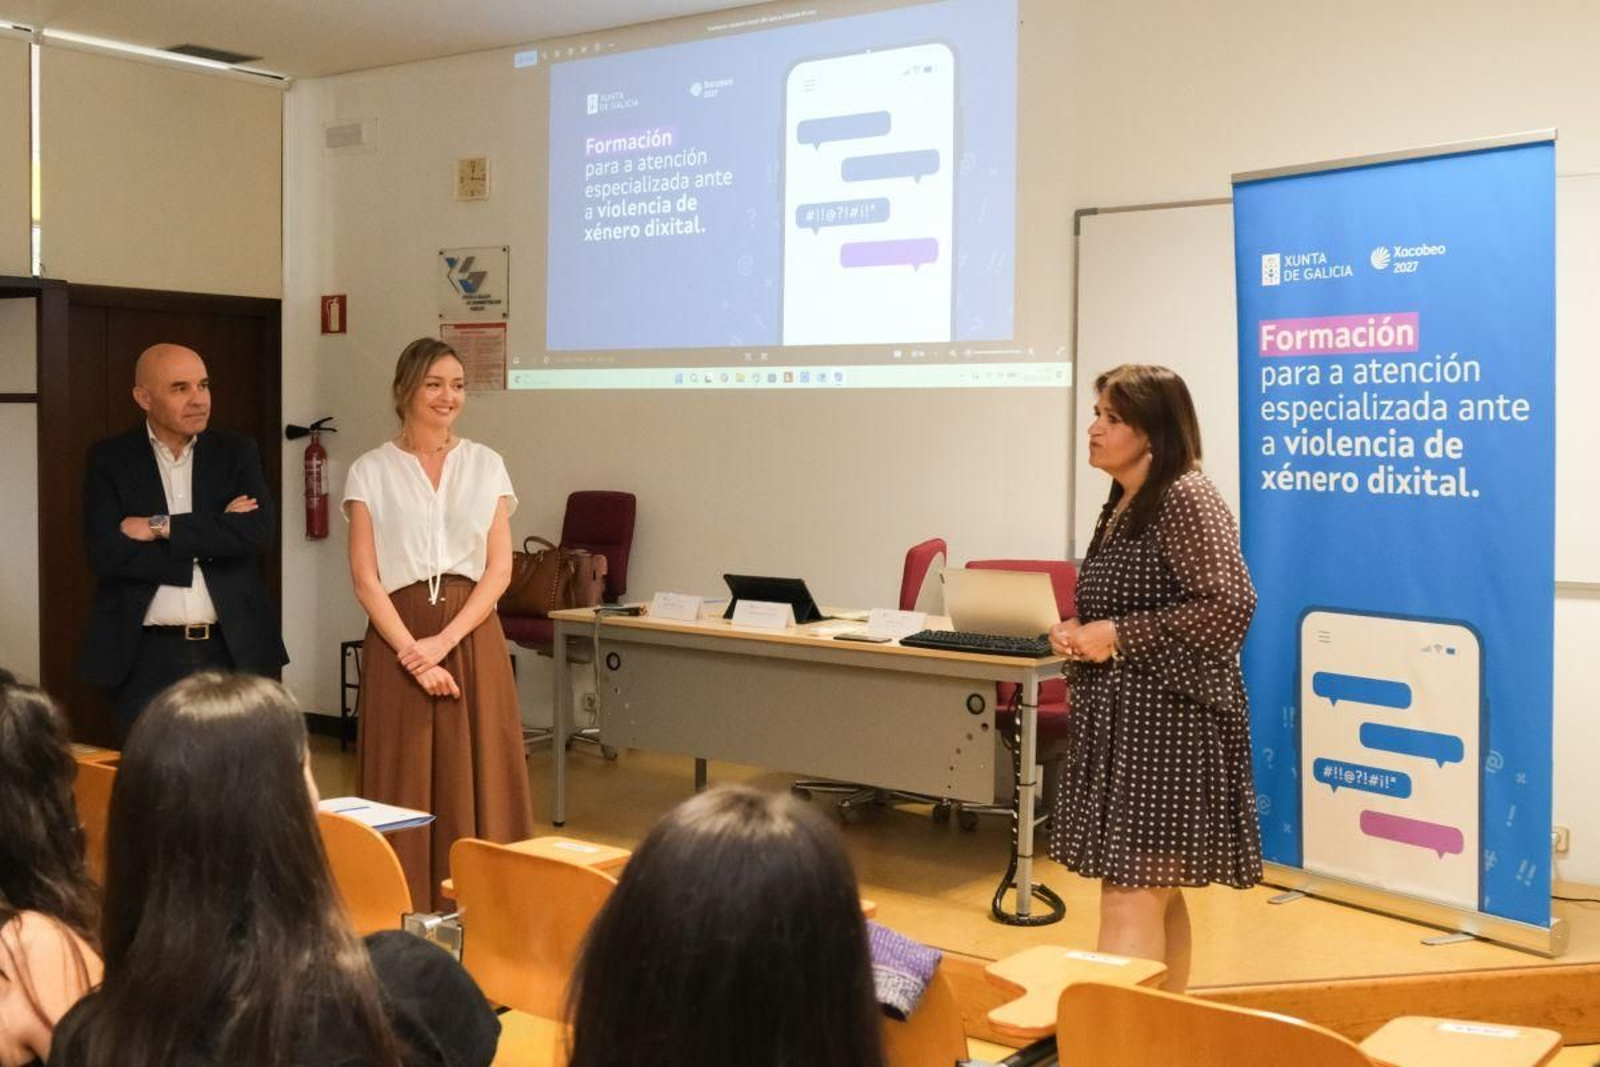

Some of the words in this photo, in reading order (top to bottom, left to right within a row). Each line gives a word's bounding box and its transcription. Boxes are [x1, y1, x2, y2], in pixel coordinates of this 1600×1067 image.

[586, 129, 673, 154] Formación
[585, 158, 619, 181] para
[623, 159, 633, 173] a
[637, 147, 708, 171] atención
[584, 173, 690, 200] especializada
[694, 170, 733, 188] ante
[584, 206, 594, 220] a
[597, 195, 671, 218] violencia
[676, 193, 698, 211] de
[584, 221, 640, 242] xénero
[644, 215, 706, 236] dixital.
[1284, 253, 1327, 267] XUNTA
[1393, 260, 1419, 273] 2027
[1393, 243, 1446, 259] Xacobeo
[1284, 269, 1300, 282] DE
[1304, 265, 1353, 280] GALICIA
[1261, 317, 1414, 351] Formación
[1261, 364, 1320, 393] para
[1329, 364, 1343, 384] a
[1353, 352, 1480, 385] atención
[1261, 391, 1448, 428] especializada
[1458, 394, 1530, 421] ante
[1262, 435, 1275, 455] a
[1284, 428, 1414, 458] violencia
[1424, 429, 1463, 459] de
[1261, 462, 1359, 493] xénero
[1367, 465, 1480, 498] dixital.
